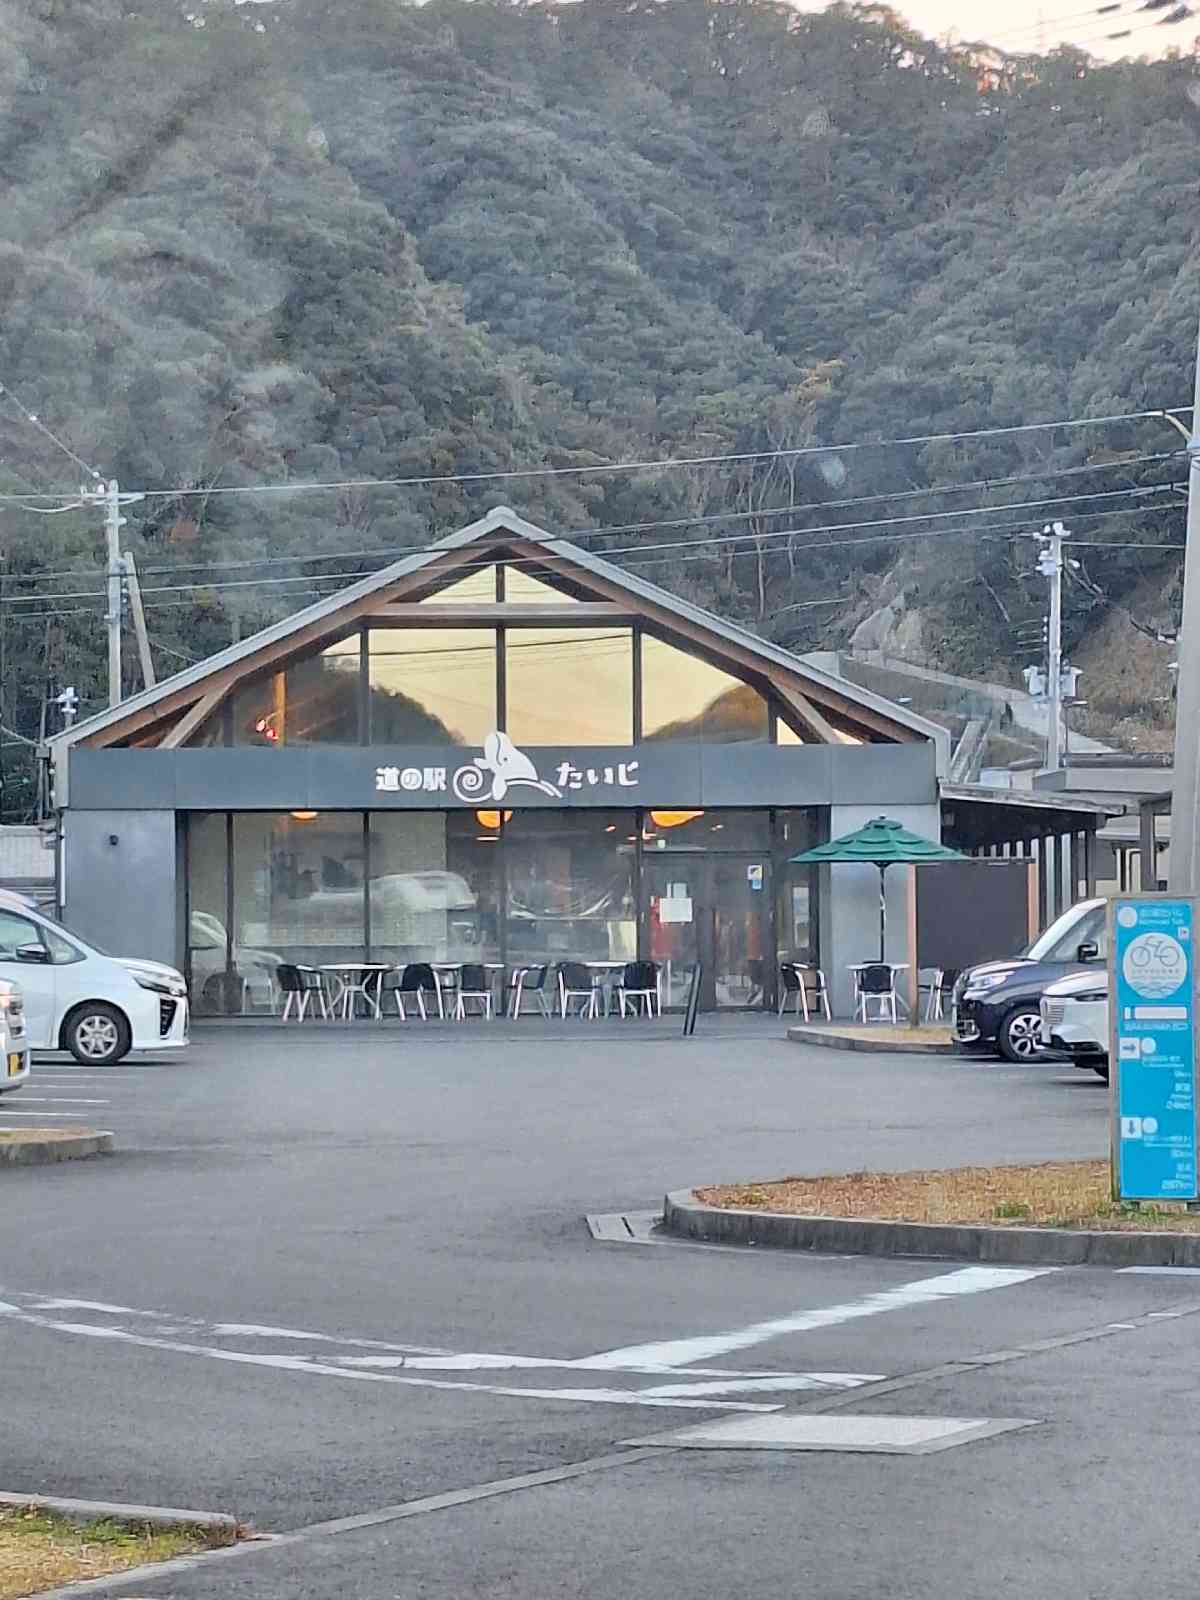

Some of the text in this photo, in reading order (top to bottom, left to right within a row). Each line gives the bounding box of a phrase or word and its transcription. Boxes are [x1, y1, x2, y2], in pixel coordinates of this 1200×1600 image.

[376, 761, 639, 791] 道の駅 たいじ
